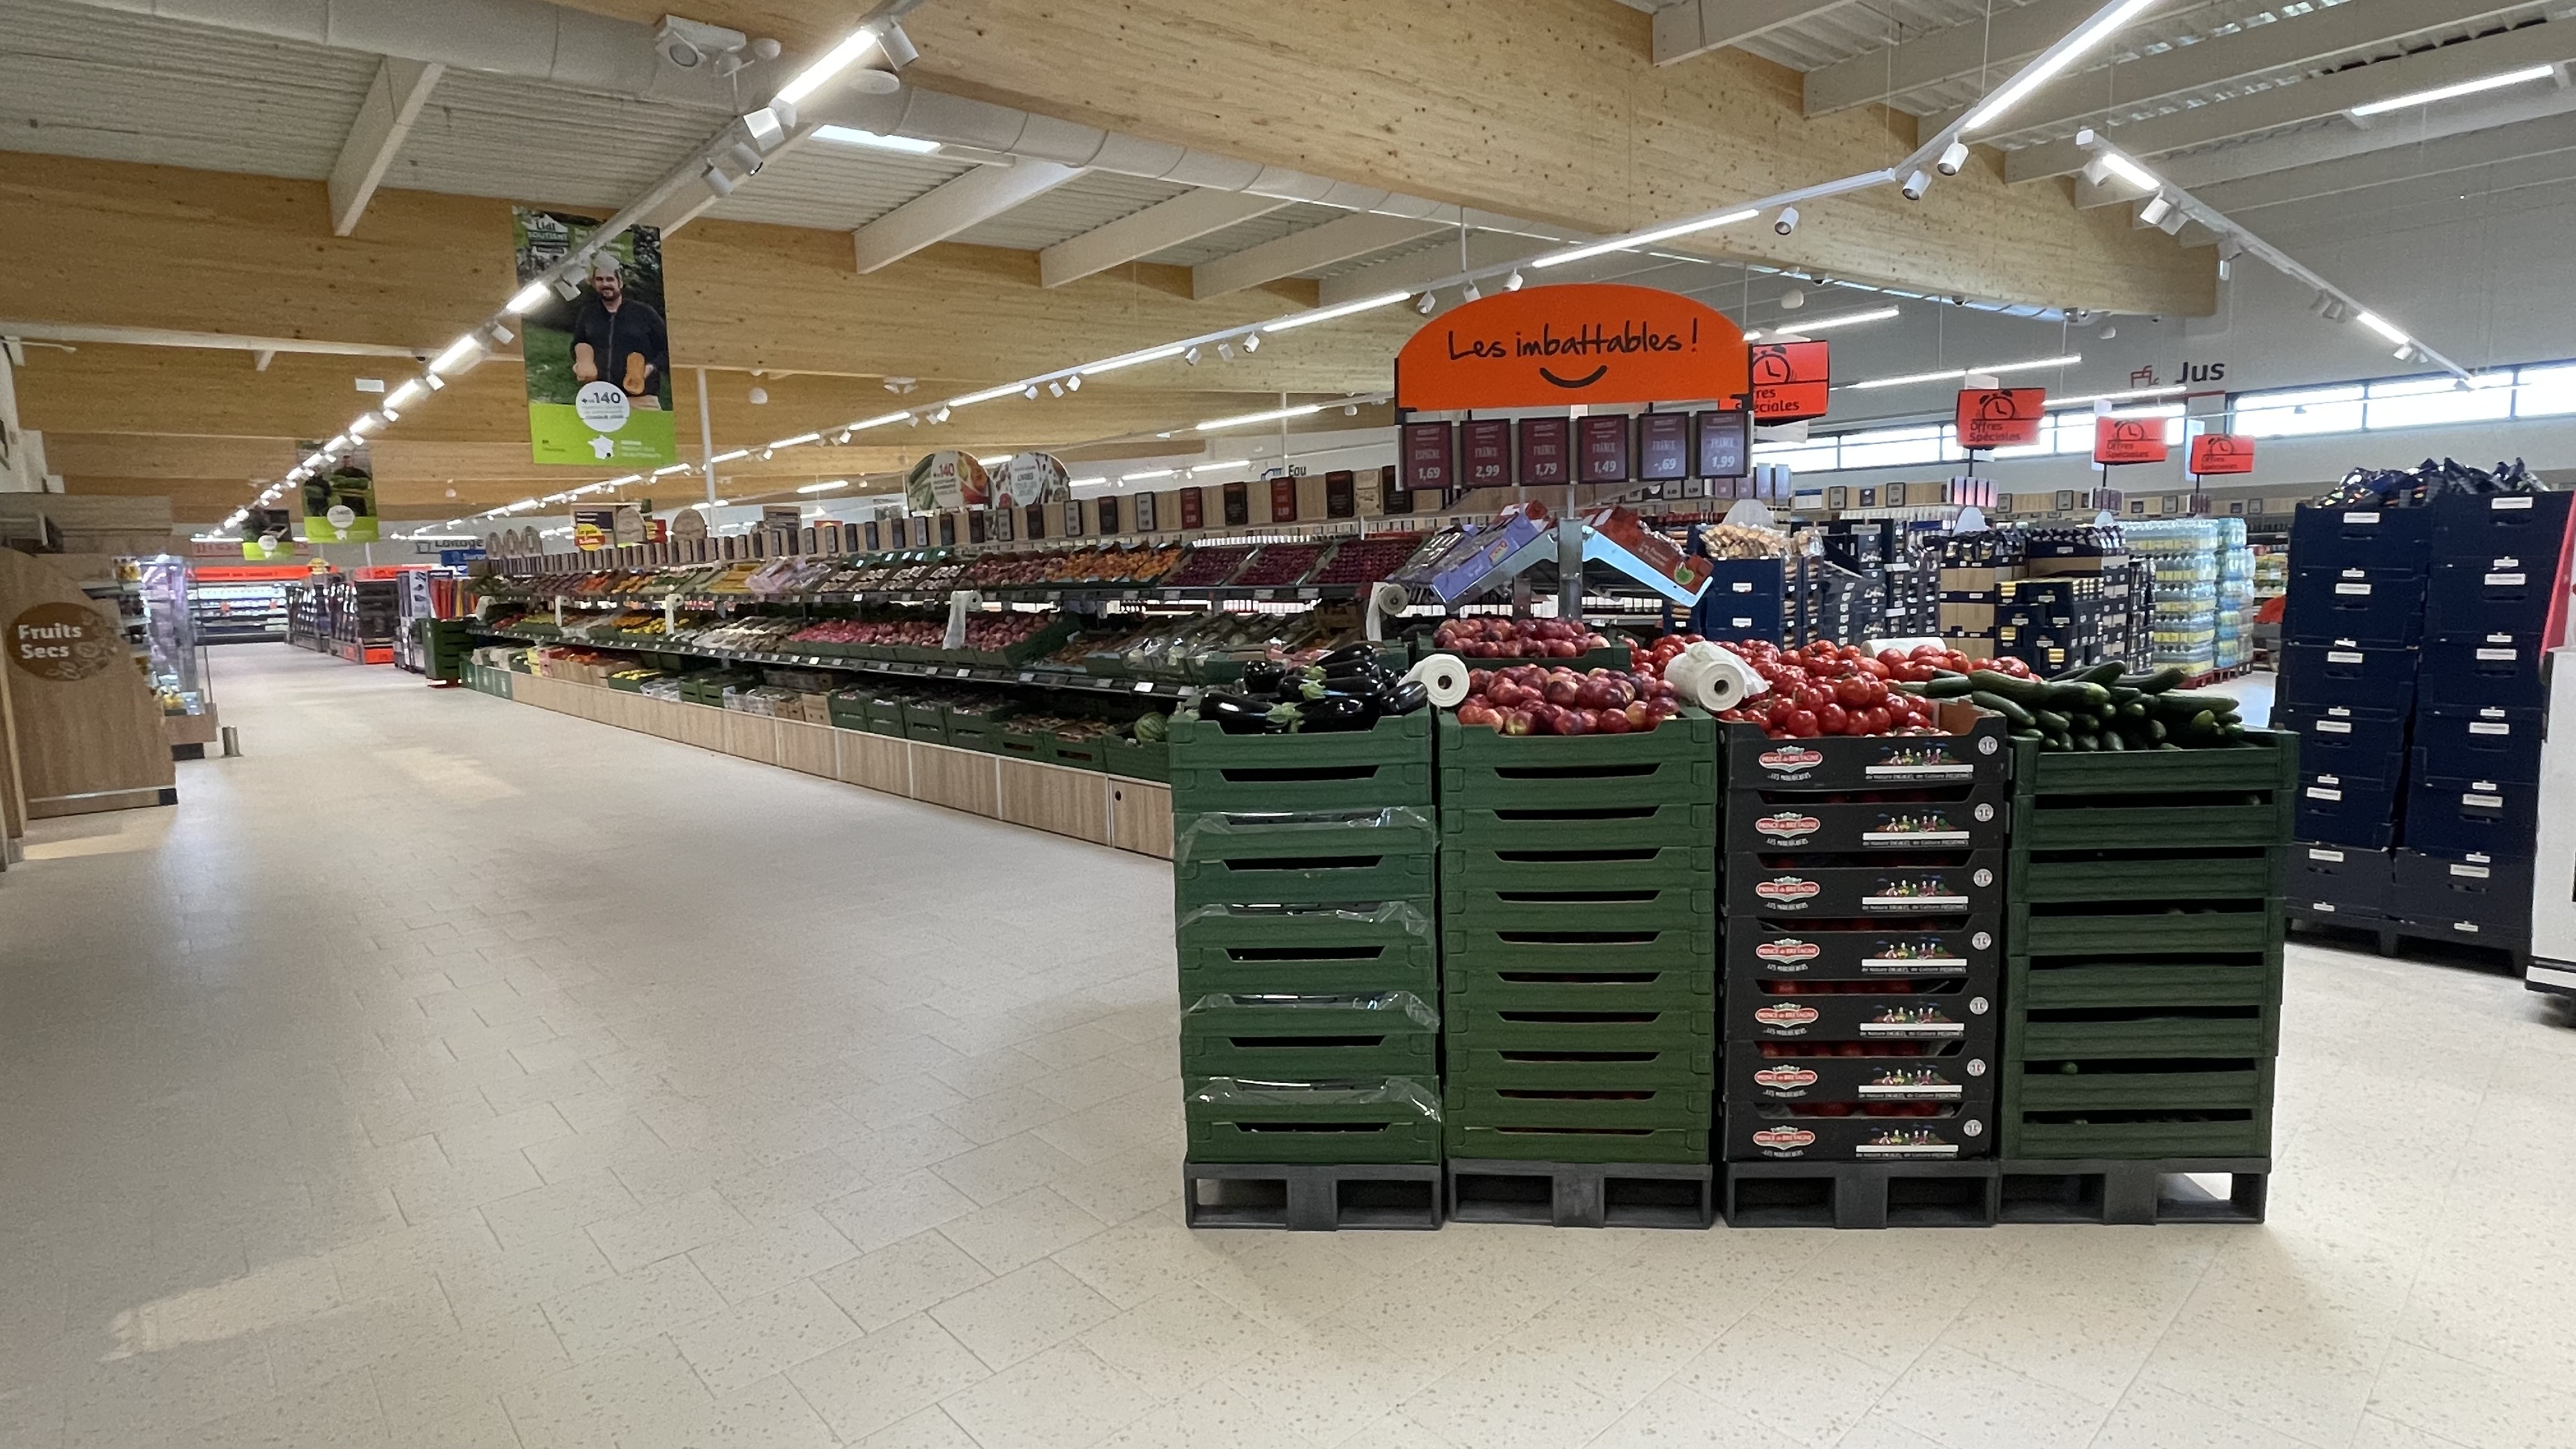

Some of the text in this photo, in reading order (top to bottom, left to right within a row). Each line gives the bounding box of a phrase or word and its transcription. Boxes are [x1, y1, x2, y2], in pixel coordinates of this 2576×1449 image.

[1448, 318, 1698, 360] Les imbattables !
[2175, 362, 2225, 383] Jus
[594, 392, 621, 404] 140
[1970, 422, 2003, 433] Offres
[1969, 432, 2021, 442] Spéciales
[939, 463, 954, 477] 140
[1535, 463, 1557, 476] 1,79
[1594, 460, 1616, 473] 1,49
[1712, 456, 1735, 470] 1,99
[1289, 464, 1307, 477] Eau
[1418, 466, 1441, 480] 1,69
[1475, 464, 1500, 479] 2,99
[18, 622, 82, 640] Fruits
[20, 643, 69, 659] Secs
